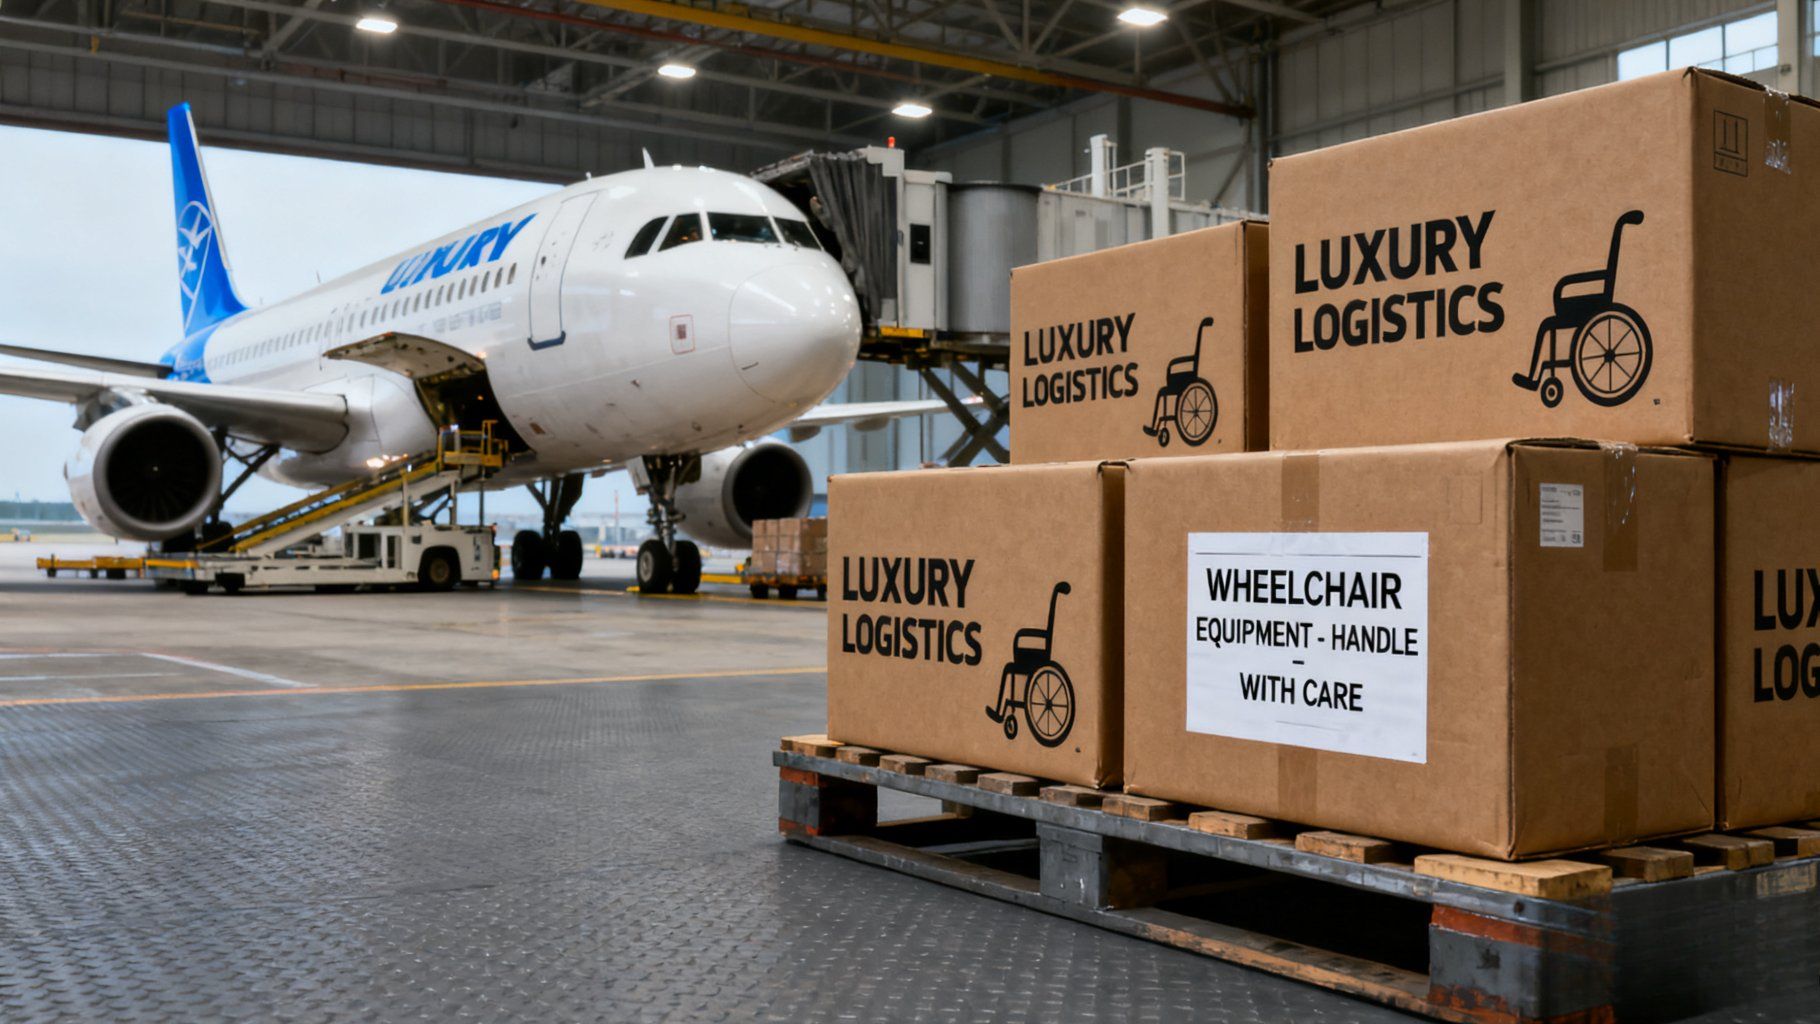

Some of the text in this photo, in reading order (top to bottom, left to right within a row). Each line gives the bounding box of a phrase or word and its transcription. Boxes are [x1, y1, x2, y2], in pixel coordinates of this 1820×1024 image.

[1294, 209, 1496, 295] LUXURY
[1023, 312, 1136, 367] LUXURY
[1293, 281, 1505, 354] LOGISTICS
[1022, 362, 1139, 409] LOGISTICS
[842, 556, 976, 609] LUXURY
[1206, 567, 1402, 610] WHEELCHAIR
[842, 613, 983, 667] LOGISTICS
[1196, 616, 1313, 649] EQUIPMENT
[1331, 623, 1419, 656] HANDLE
[1239, 672, 1364, 712] WITH CARE
[1753, 642, 1820, 703] LOG
